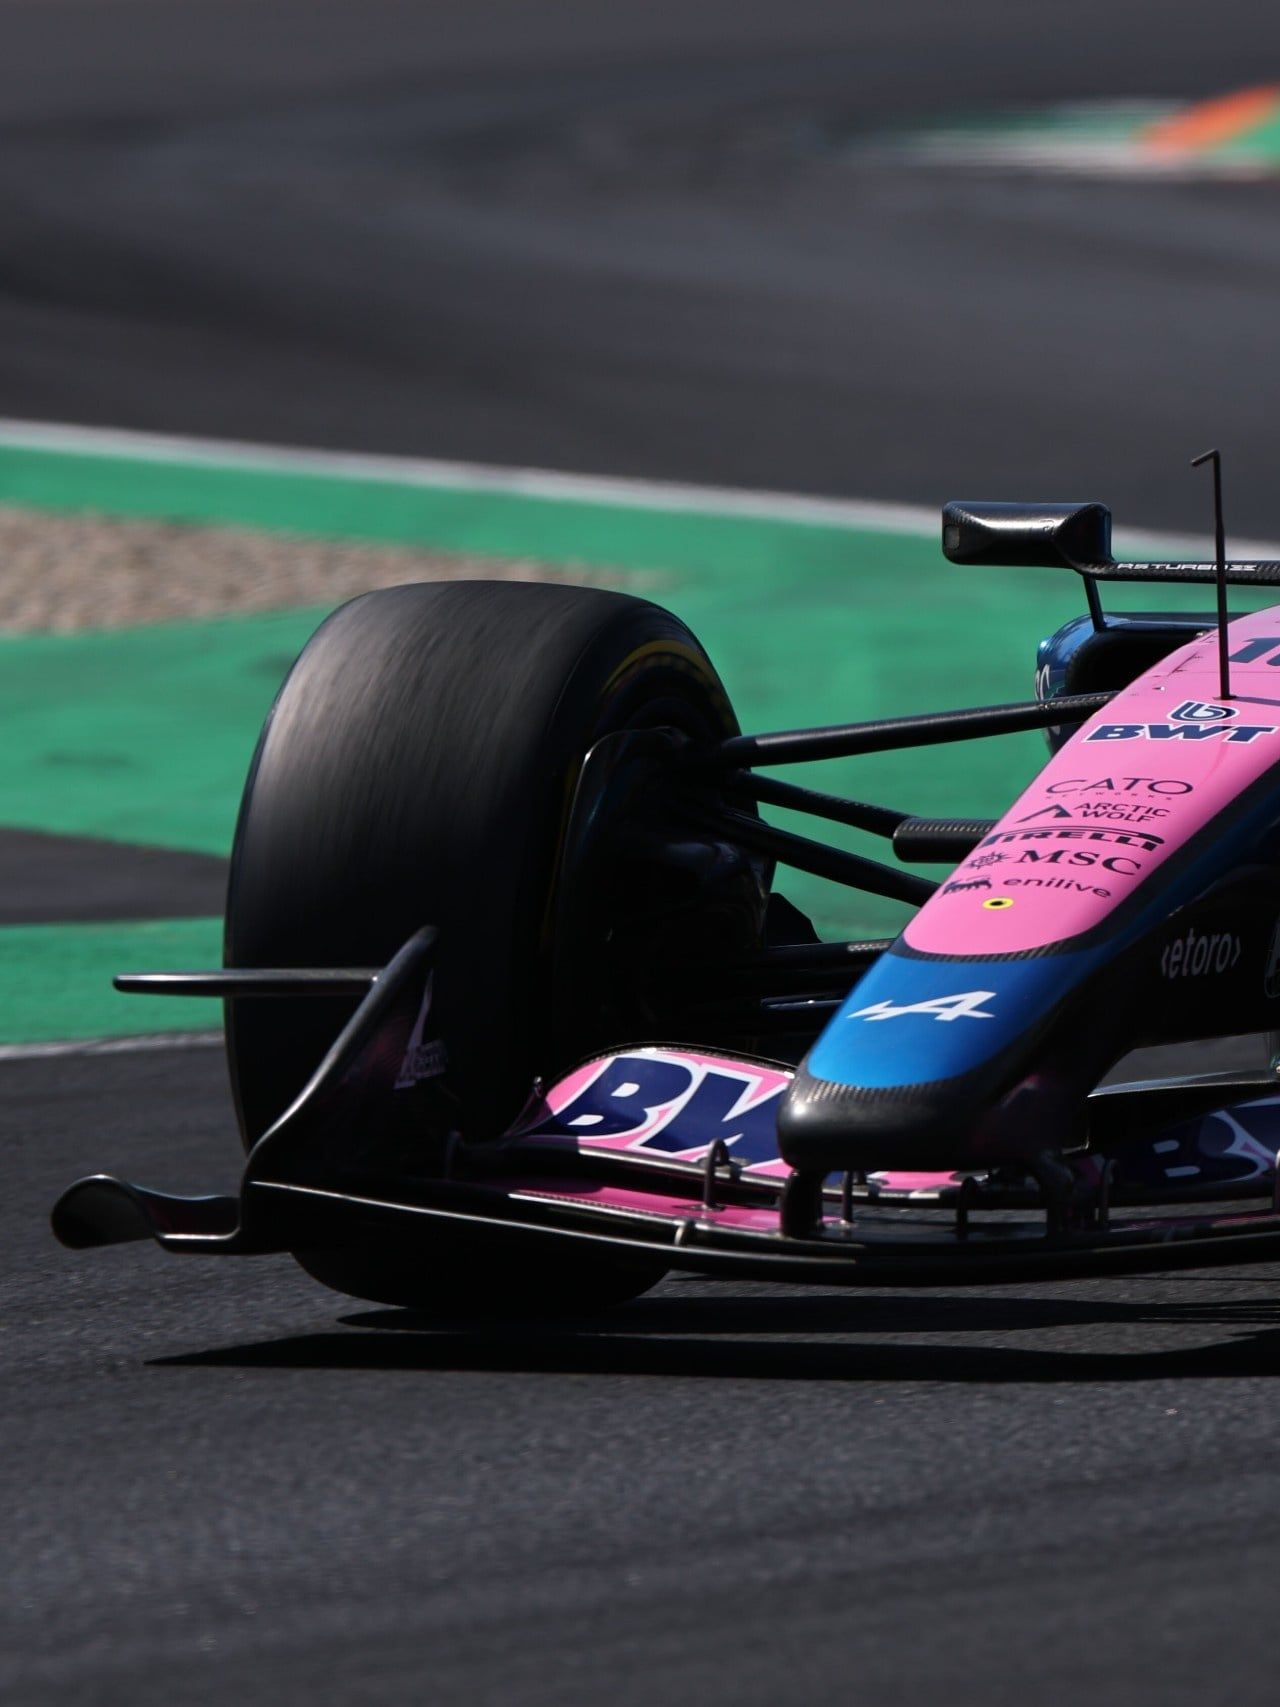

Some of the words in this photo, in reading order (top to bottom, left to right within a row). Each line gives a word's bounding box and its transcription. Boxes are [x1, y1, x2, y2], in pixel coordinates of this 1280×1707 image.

[1083, 723, 1280, 744] BWT
[1046, 777, 1193, 795] CATO
[1074, 802, 1171, 817] ARCTIC
[1081, 810, 1155, 823] WOLF
[979, 825, 1166, 852] PIRELLI
[1013, 849, 1142, 876] MSC
[1003, 877, 1112, 898] enilive
[538, 1052, 790, 1168] BW
